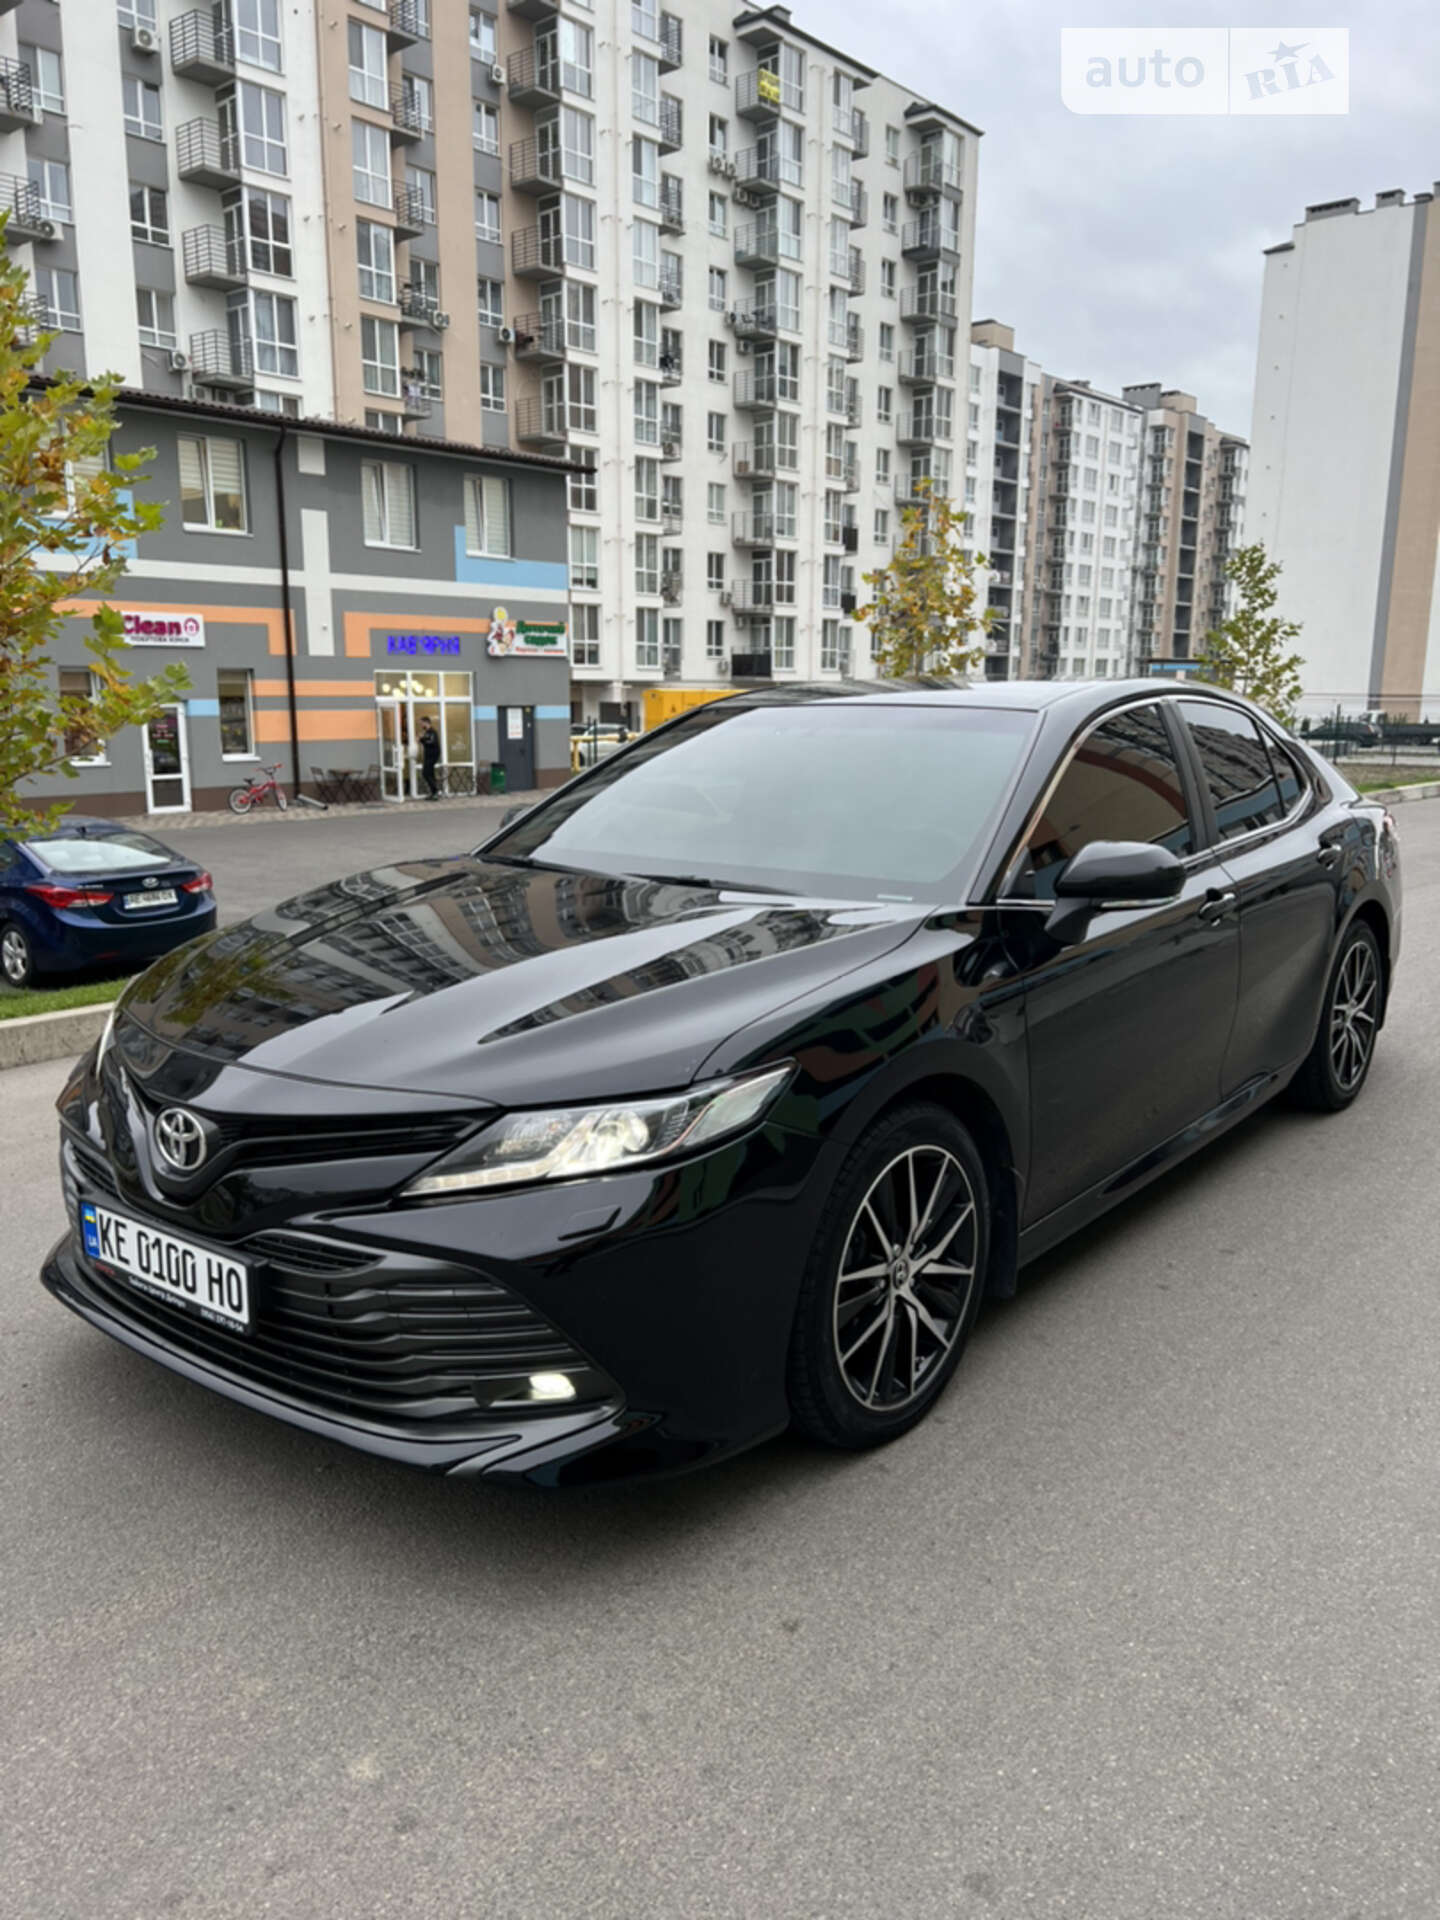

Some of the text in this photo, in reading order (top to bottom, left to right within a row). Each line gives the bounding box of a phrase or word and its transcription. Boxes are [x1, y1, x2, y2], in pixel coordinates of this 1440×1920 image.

[123, 614, 182, 635] Clean
[99, 1213, 130, 1266] KE
[137, 1230, 197, 1294] 0100
[207, 1257, 243, 1314] HO
